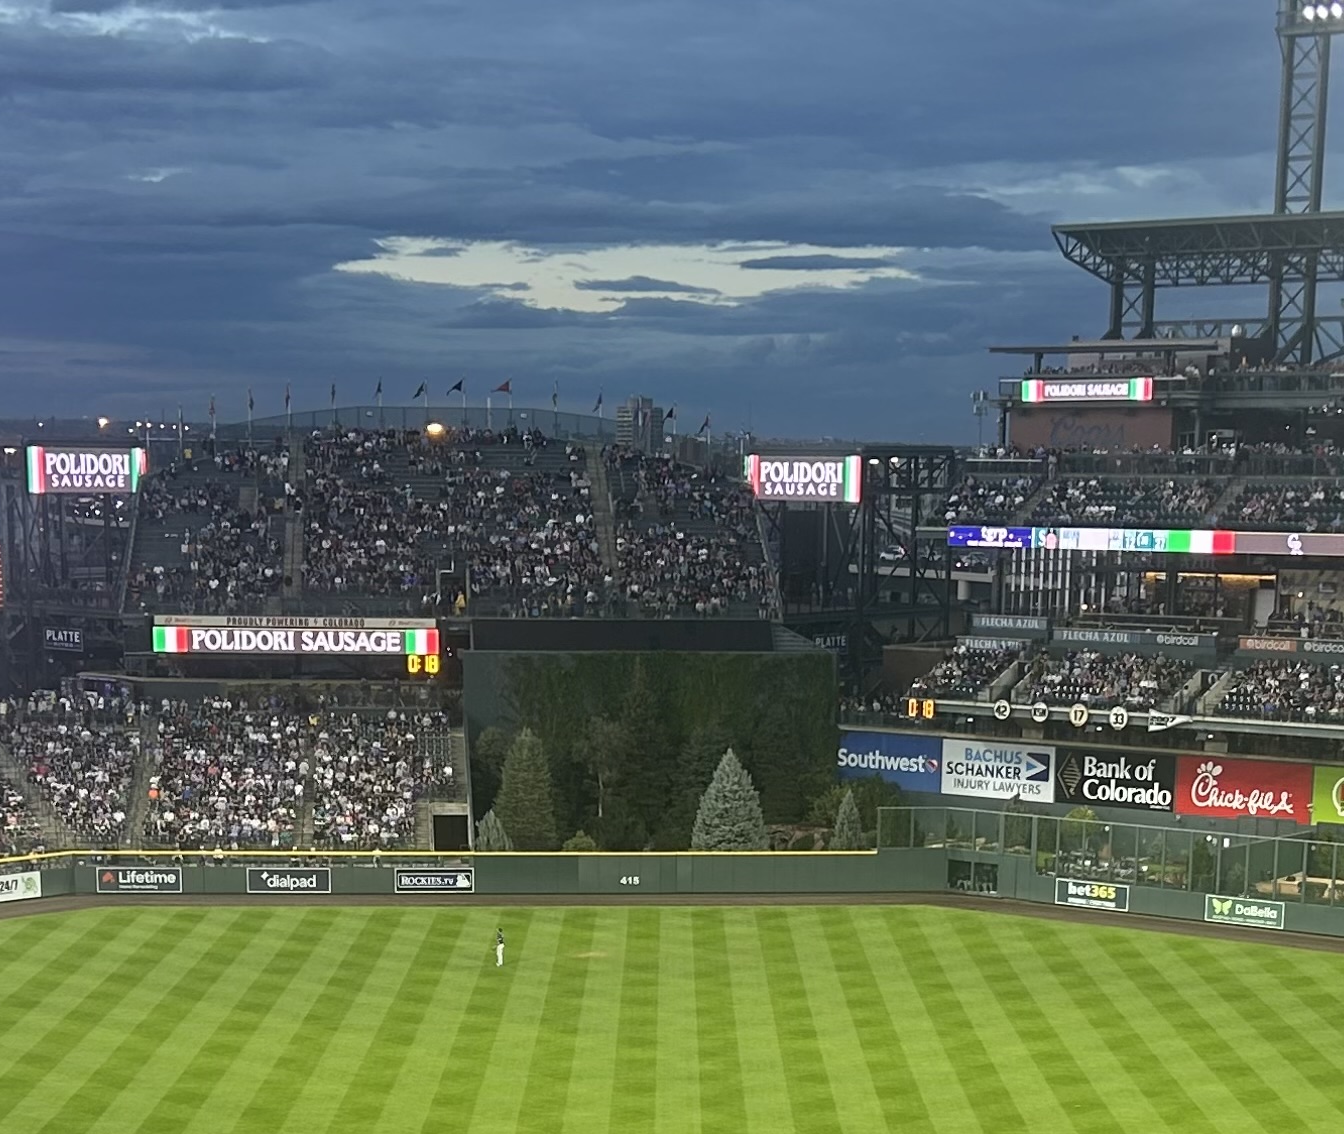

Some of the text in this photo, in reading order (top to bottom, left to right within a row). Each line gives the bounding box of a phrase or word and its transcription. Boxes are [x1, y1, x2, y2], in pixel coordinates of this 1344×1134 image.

[45, 452, 131, 476] POLIDORI
[759, 461, 844, 484] POLIDORI
[51, 475, 125, 488] SAUSAGE
[764, 483, 839, 497] SAUSAGE
[226, 616, 365, 629] PROUDLY POWERING COLORADO
[981, 617, 1040, 629] FLECHA AZUL
[46, 629, 80, 644] PLATTE
[191, 629, 402, 652] POLIDORI SAUSAGE
[814, 635, 846, 648] PLATTE
[1062, 630, 1130, 643] FLECHA AZUL
[1164, 634, 1199, 646] birdcall
[407, 655, 439, 674] 0:18
[995, 705, 1008, 717] 42
[1073, 709, 1085, 722] 17
[1111, 711, 1125, 724] 33
[837, 748, 926, 774] Southwest
[964, 747, 1023, 765] BACHUS
[946, 761, 1022, 781] SCHANKER
[1083, 756, 1157, 781] Bank of
[953, 778, 1041, 795] INJURY LAWYERS
[1082, 778, 1172, 806] Colorado
[118, 871, 177, 885] Lifetime
[266, 874, 317, 890] dialpad
[620, 876, 640, 886] 415
[1067, 882, 1116, 899] bet365
[1234, 903, 1278, 918] DaBella
